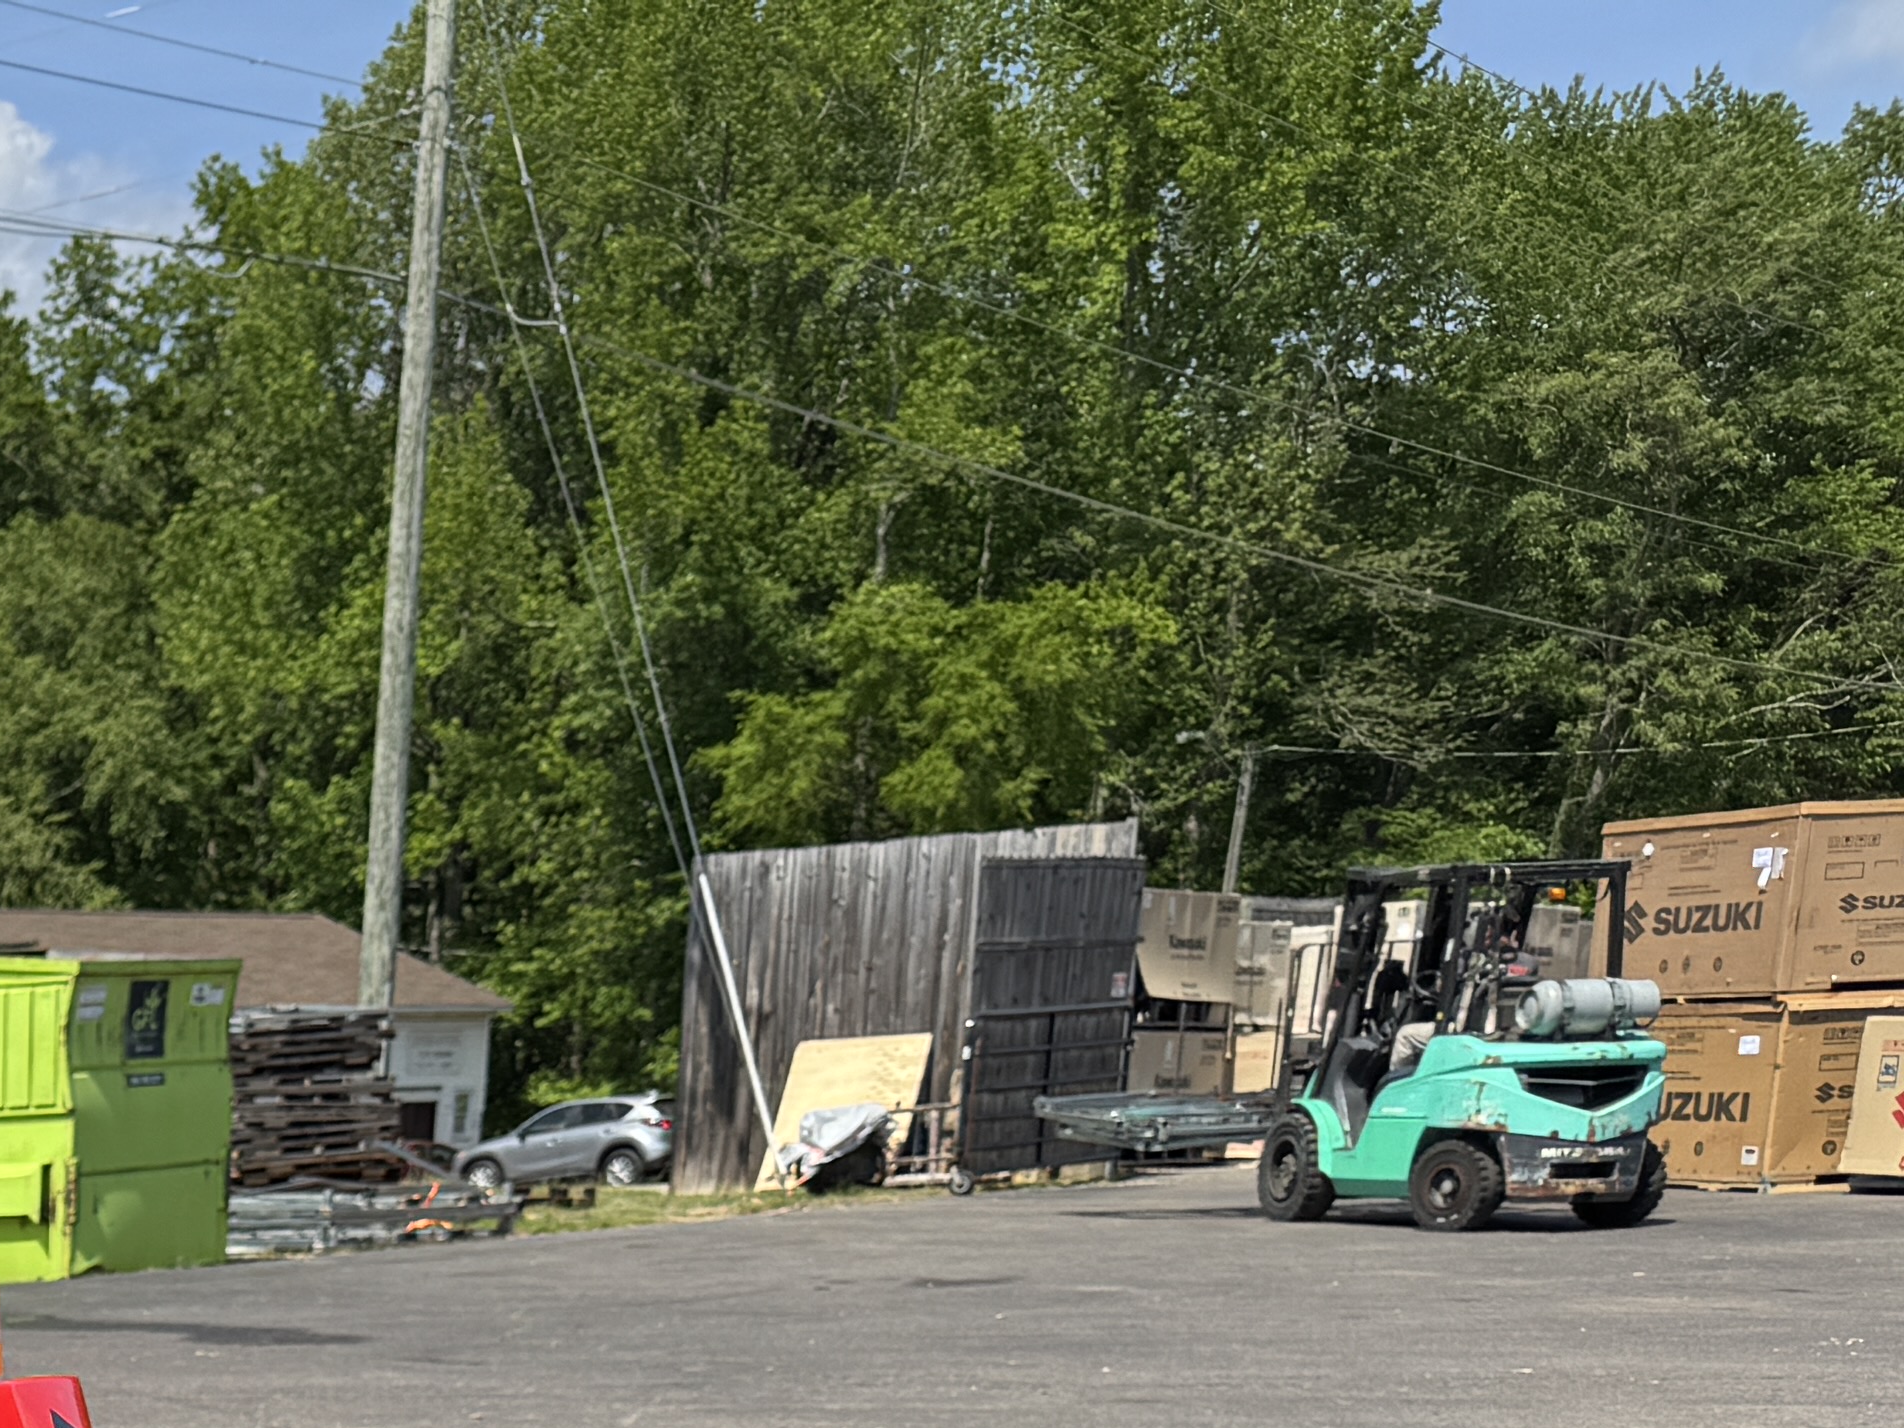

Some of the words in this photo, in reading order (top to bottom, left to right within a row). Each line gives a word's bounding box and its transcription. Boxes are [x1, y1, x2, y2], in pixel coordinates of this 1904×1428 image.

[1861, 894, 1904, 910] SUZ
[1652, 901, 1763, 936] SUZUKI
[1660, 1091, 1750, 1122] UZUKI
